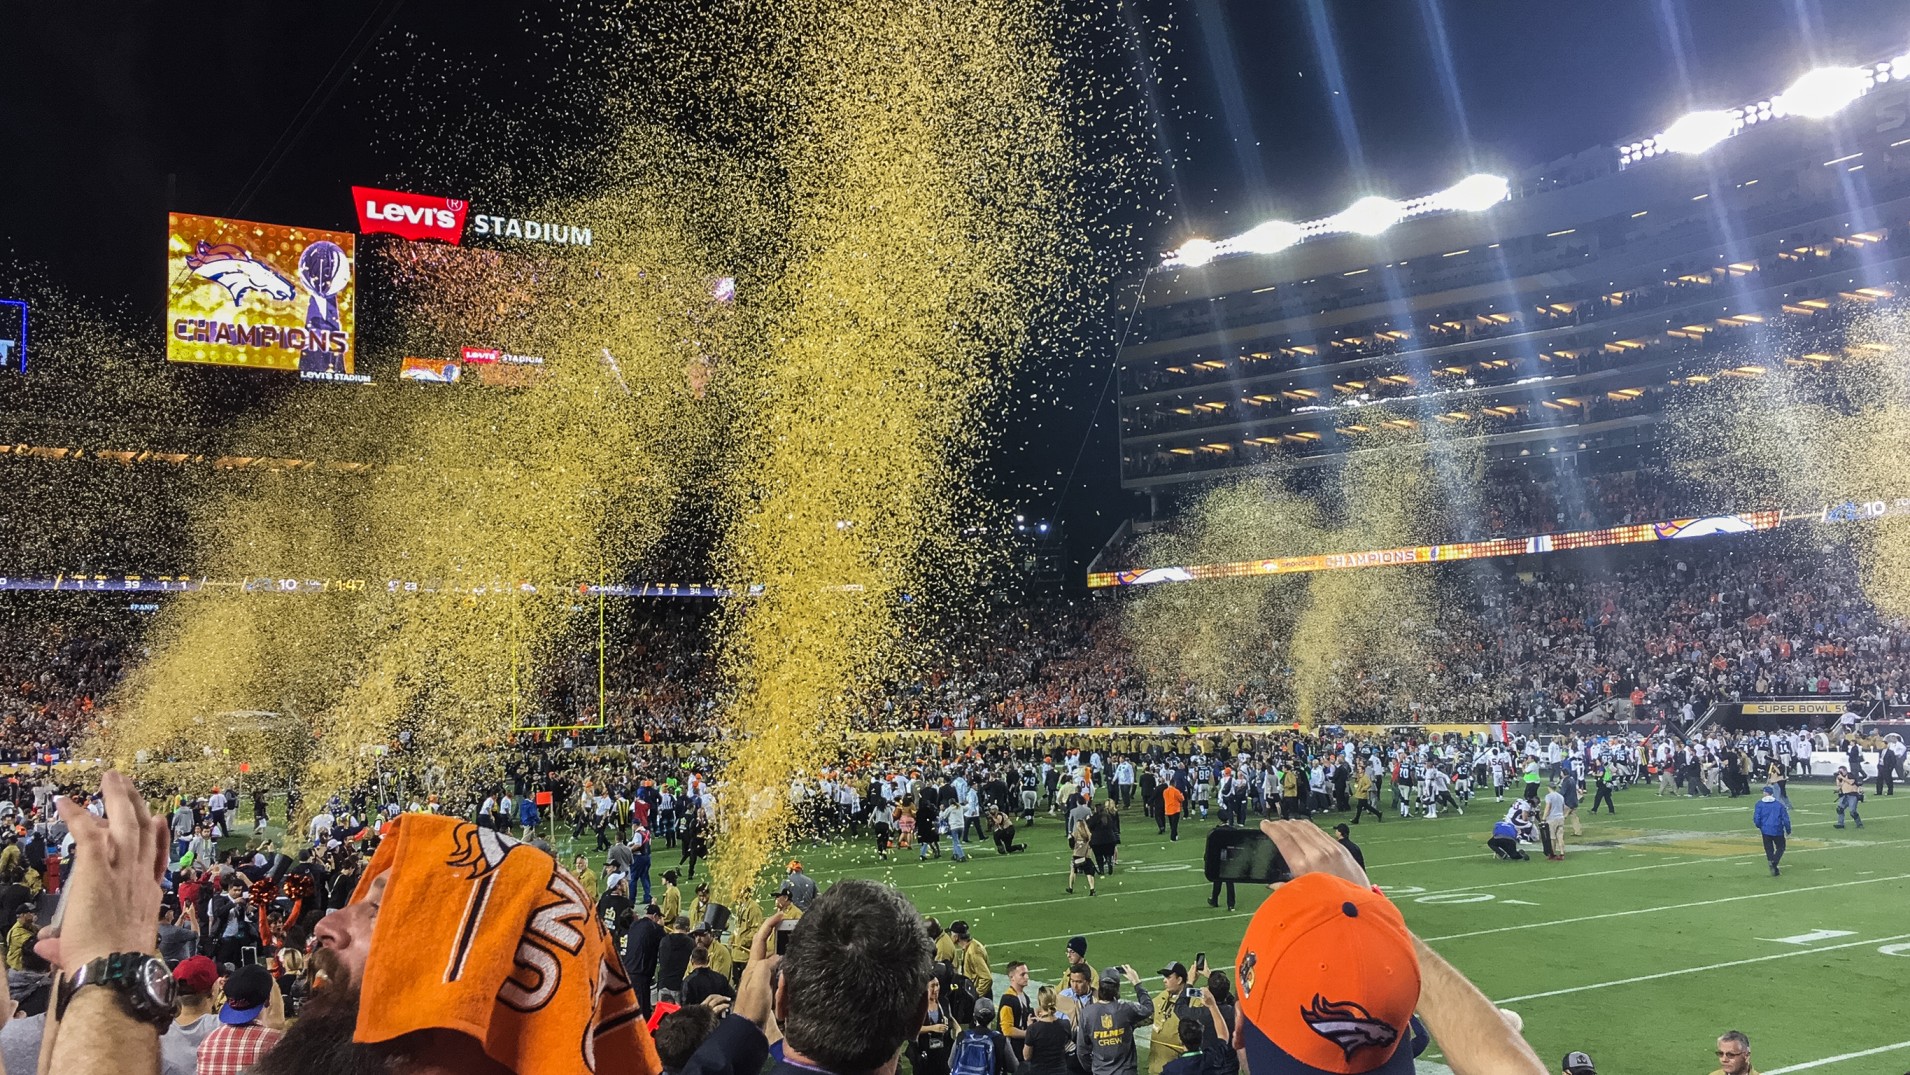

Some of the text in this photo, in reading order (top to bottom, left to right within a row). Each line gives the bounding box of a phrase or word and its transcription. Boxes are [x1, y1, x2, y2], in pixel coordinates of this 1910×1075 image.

[474, 214, 593, 246] STADIUM
[173, 318, 349, 354] CHAMPIONS
[334, 373, 372, 383] STADIUM
[1863, 501, 1886, 516] 10
[1325, 550, 1415, 568] CHAMPIONS
[96, 580, 105, 589] 2
[124, 580, 140, 589] 39
[278, 578, 298, 591] 10
[335, 579, 366, 591] 1:47
[1757, 704, 1795, 713] SUPER
[1799, 704, 1832, 713] BOWL
[1023, 776, 1036, 787] 79
[1093, 1028, 1125, 1040] FILMS
[1098, 1037, 1123, 1047] CREW
